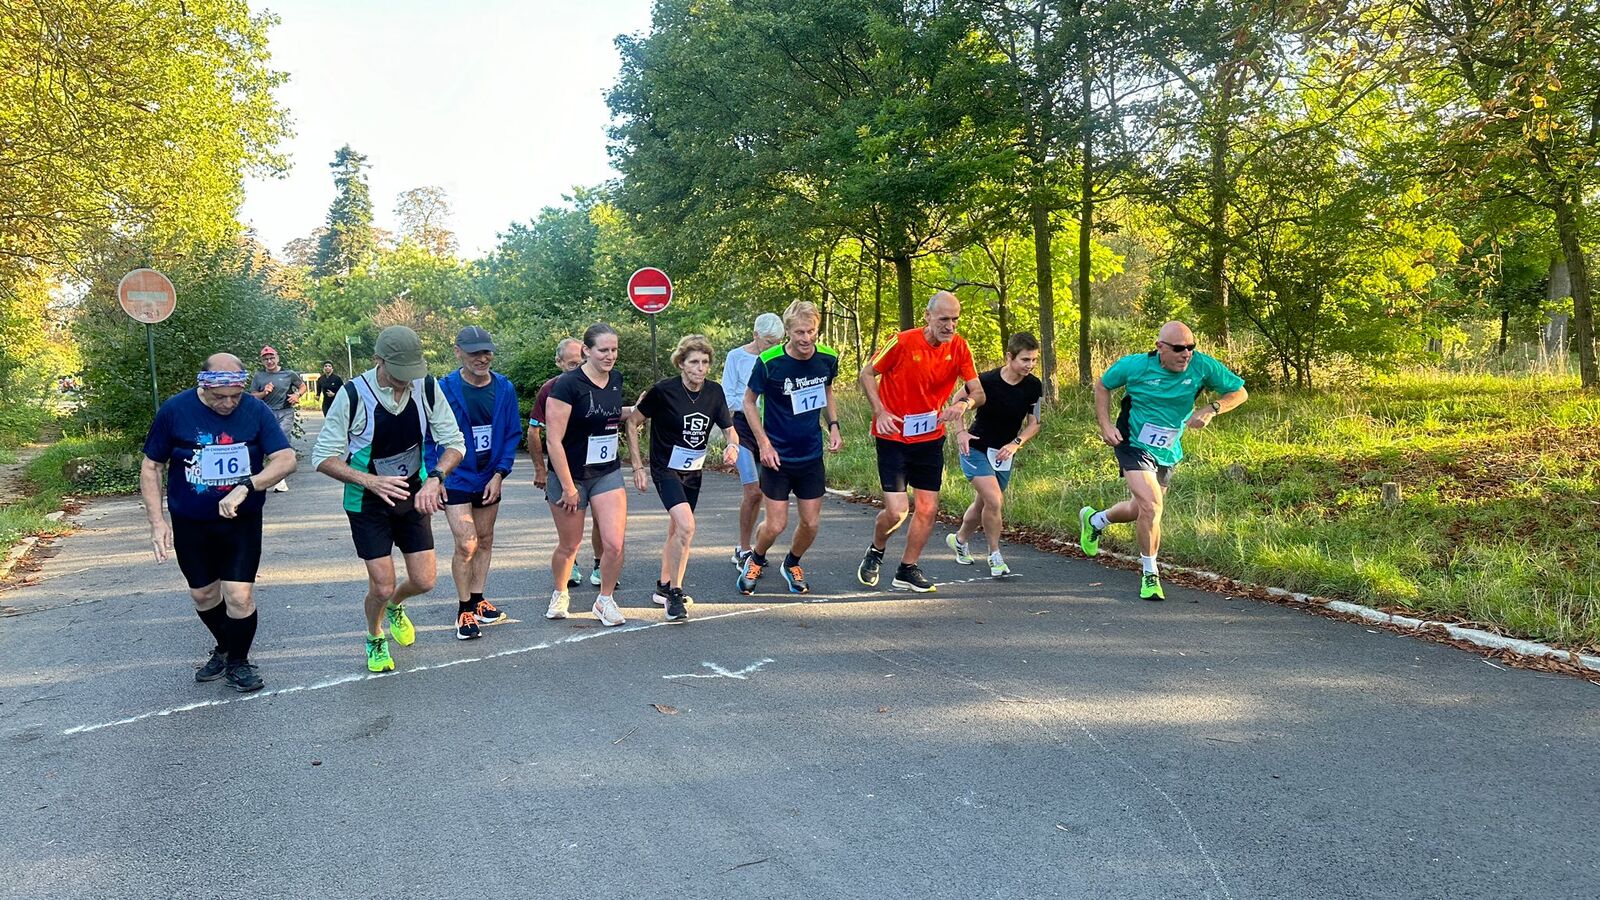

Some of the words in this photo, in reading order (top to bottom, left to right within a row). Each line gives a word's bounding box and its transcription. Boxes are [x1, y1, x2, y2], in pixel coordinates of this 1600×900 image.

[801, 395, 818, 410] 17
[913, 420, 928, 434] 11
[474, 434, 490, 449] 13
[1149, 433, 1168, 447] 15
[600, 445, 608, 459] 8
[214, 457, 239, 475] 16
[683, 457, 694, 469] 5
[397, 464, 409, 477] 3
